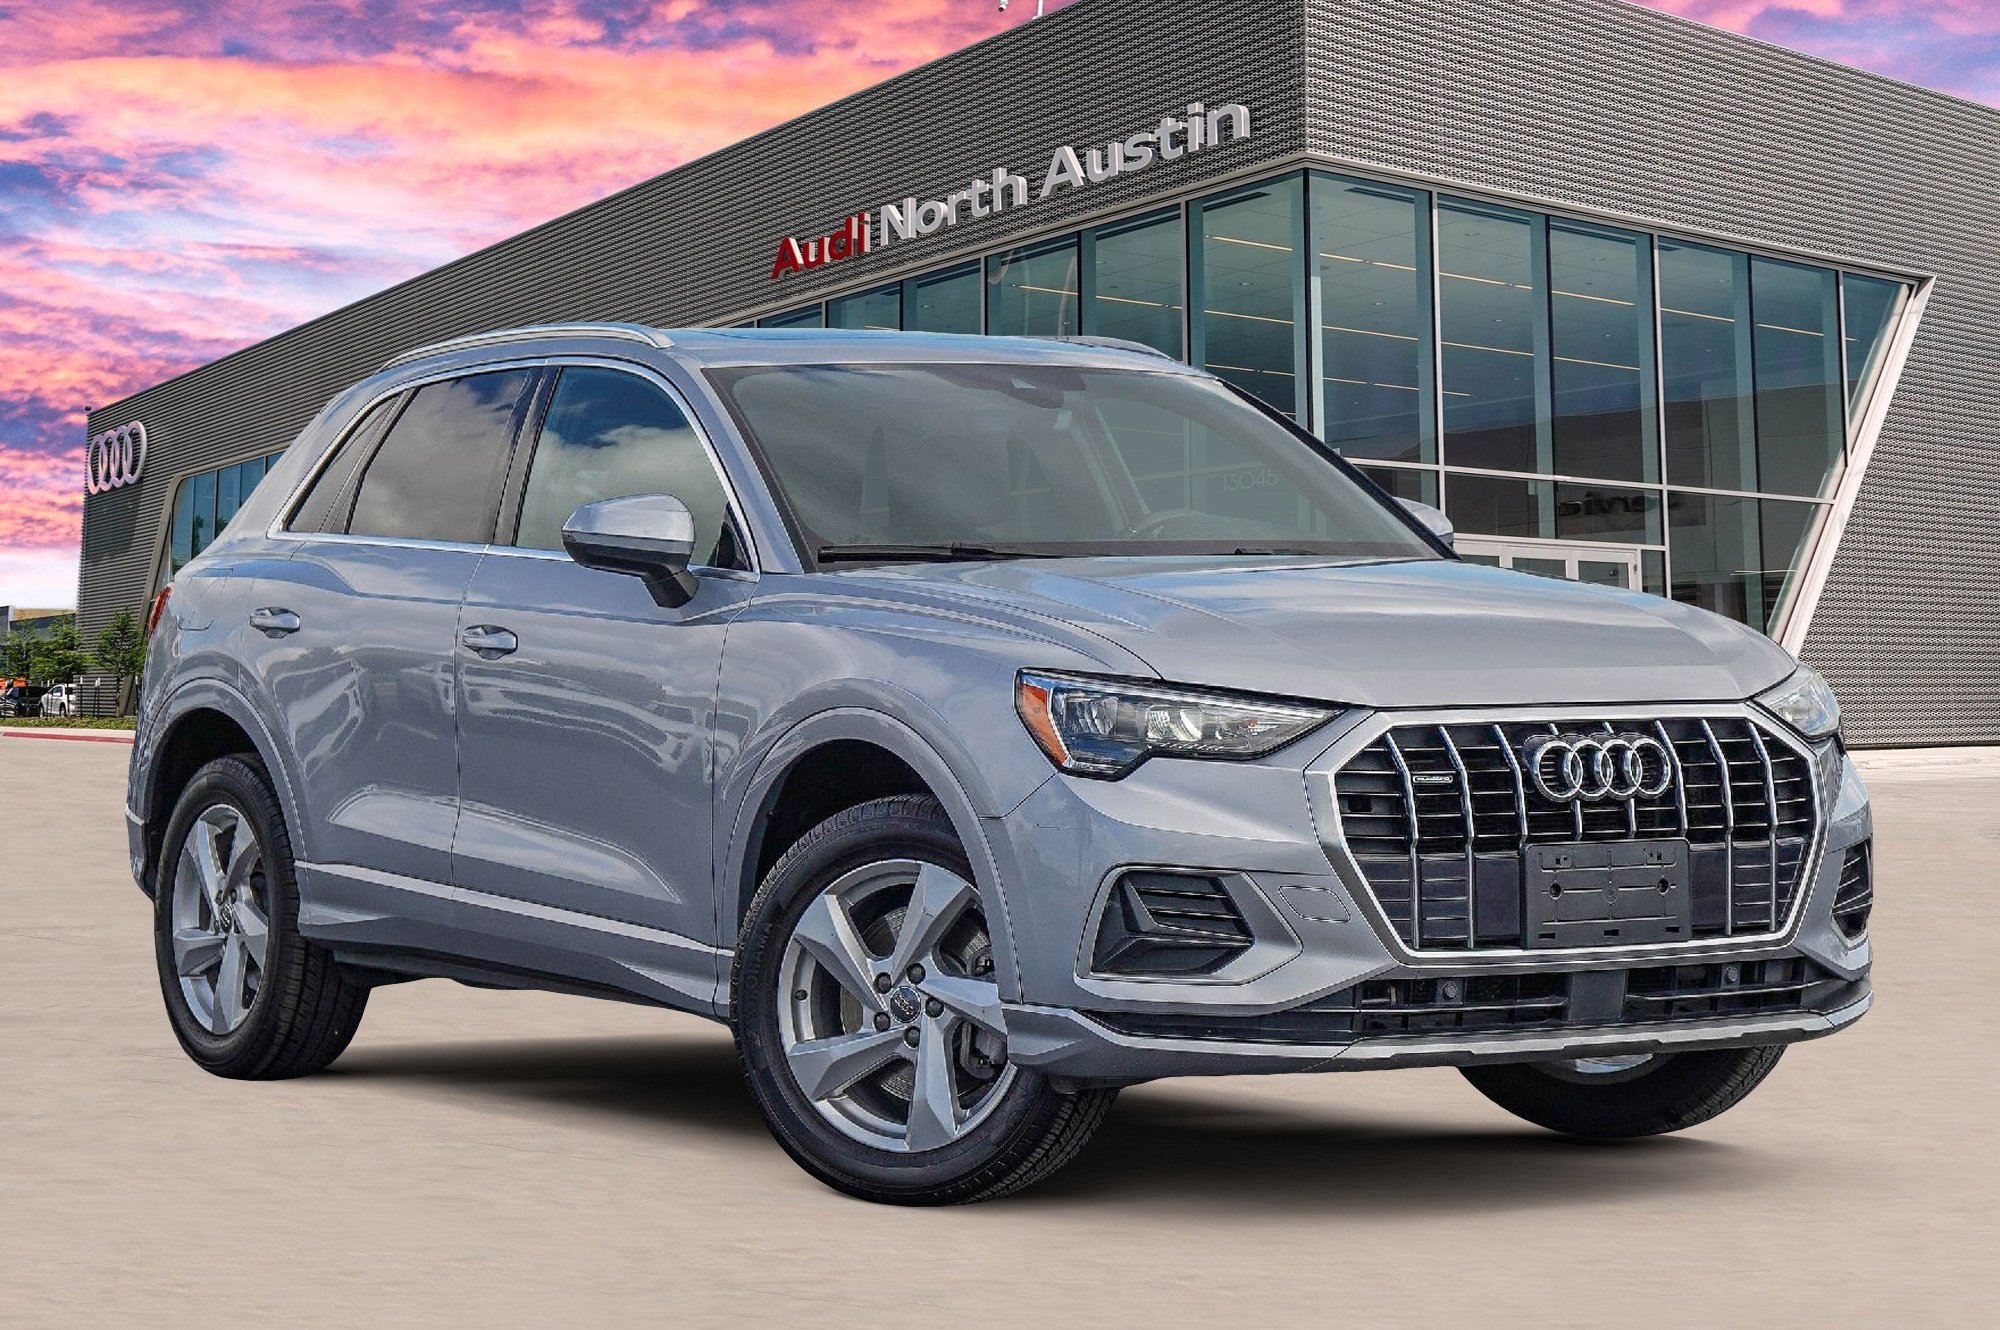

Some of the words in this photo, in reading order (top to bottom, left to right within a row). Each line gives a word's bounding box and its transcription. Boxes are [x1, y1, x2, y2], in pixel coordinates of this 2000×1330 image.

[772, 213, 871, 279] Audi
[880, 167, 1028, 246] North
[1040, 102, 1250, 197] Austin
[1222, 469, 1278, 491] 13045
